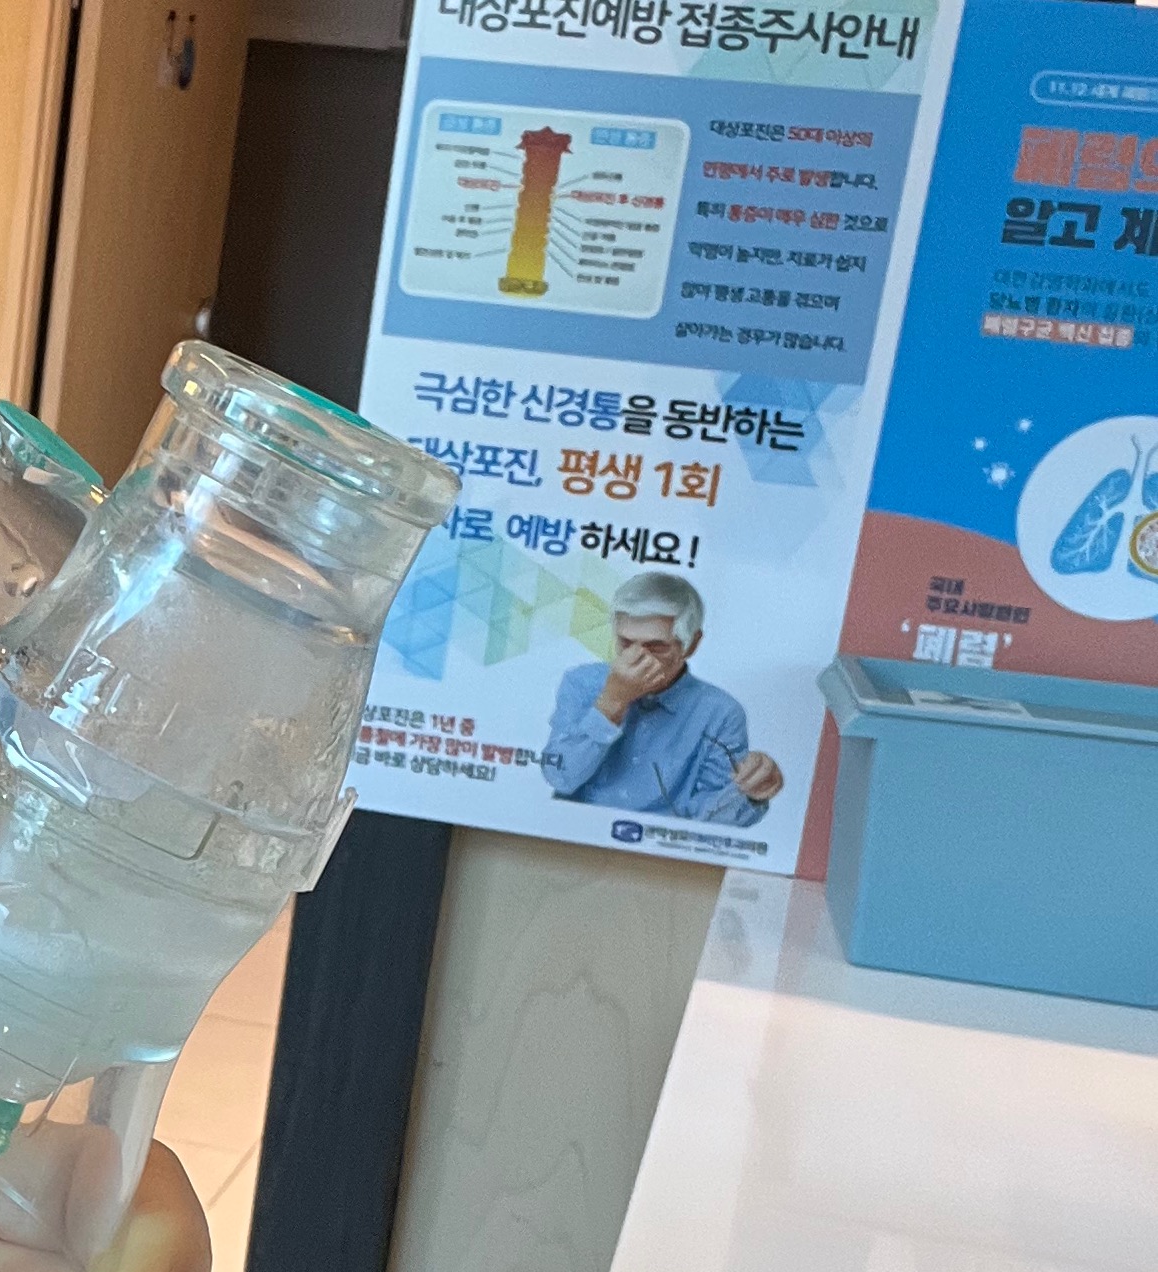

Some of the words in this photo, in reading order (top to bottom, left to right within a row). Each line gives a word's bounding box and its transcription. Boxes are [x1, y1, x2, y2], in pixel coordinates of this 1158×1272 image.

[438, 0, 671, 44] 대상포진예방
[679, 3, 921, 60] 접종주사안내
[710, 119, 785, 142] 대상포진은
[788, 126, 823, 143] 50대
[825, 130, 873, 148] 이상의
[766, 165, 795, 183] 주로
[843, 213, 889, 232] 것으로
[1000, 197, 1101, 249] 알고
[787, 250, 832, 270] 치료가
[835, 253, 866, 273] 쉽지
[714, 284, 745, 302] 평생
[675, 321, 733, 345] 살아가는
[737, 326, 781, 346] 경우가
[414, 371, 515, 419] 극심한
[521, 384, 657, 436] 신경통을
[663, 399, 805, 451] 동반하는
[556, 447, 644, 501] 평생
[654, 463, 722, 507] 1회
[506, 513, 576, 556] 예방
[364, 705, 425, 730] 상포진은
[430, 714, 456, 733] 1년
[460, 718, 476, 737] 중
[410, 734, 441, 754] 가장
[445, 738, 478, 758] 많이
[375, 750, 407, 768] 바로
[410, 755, 497, 782] 상담하세요!
